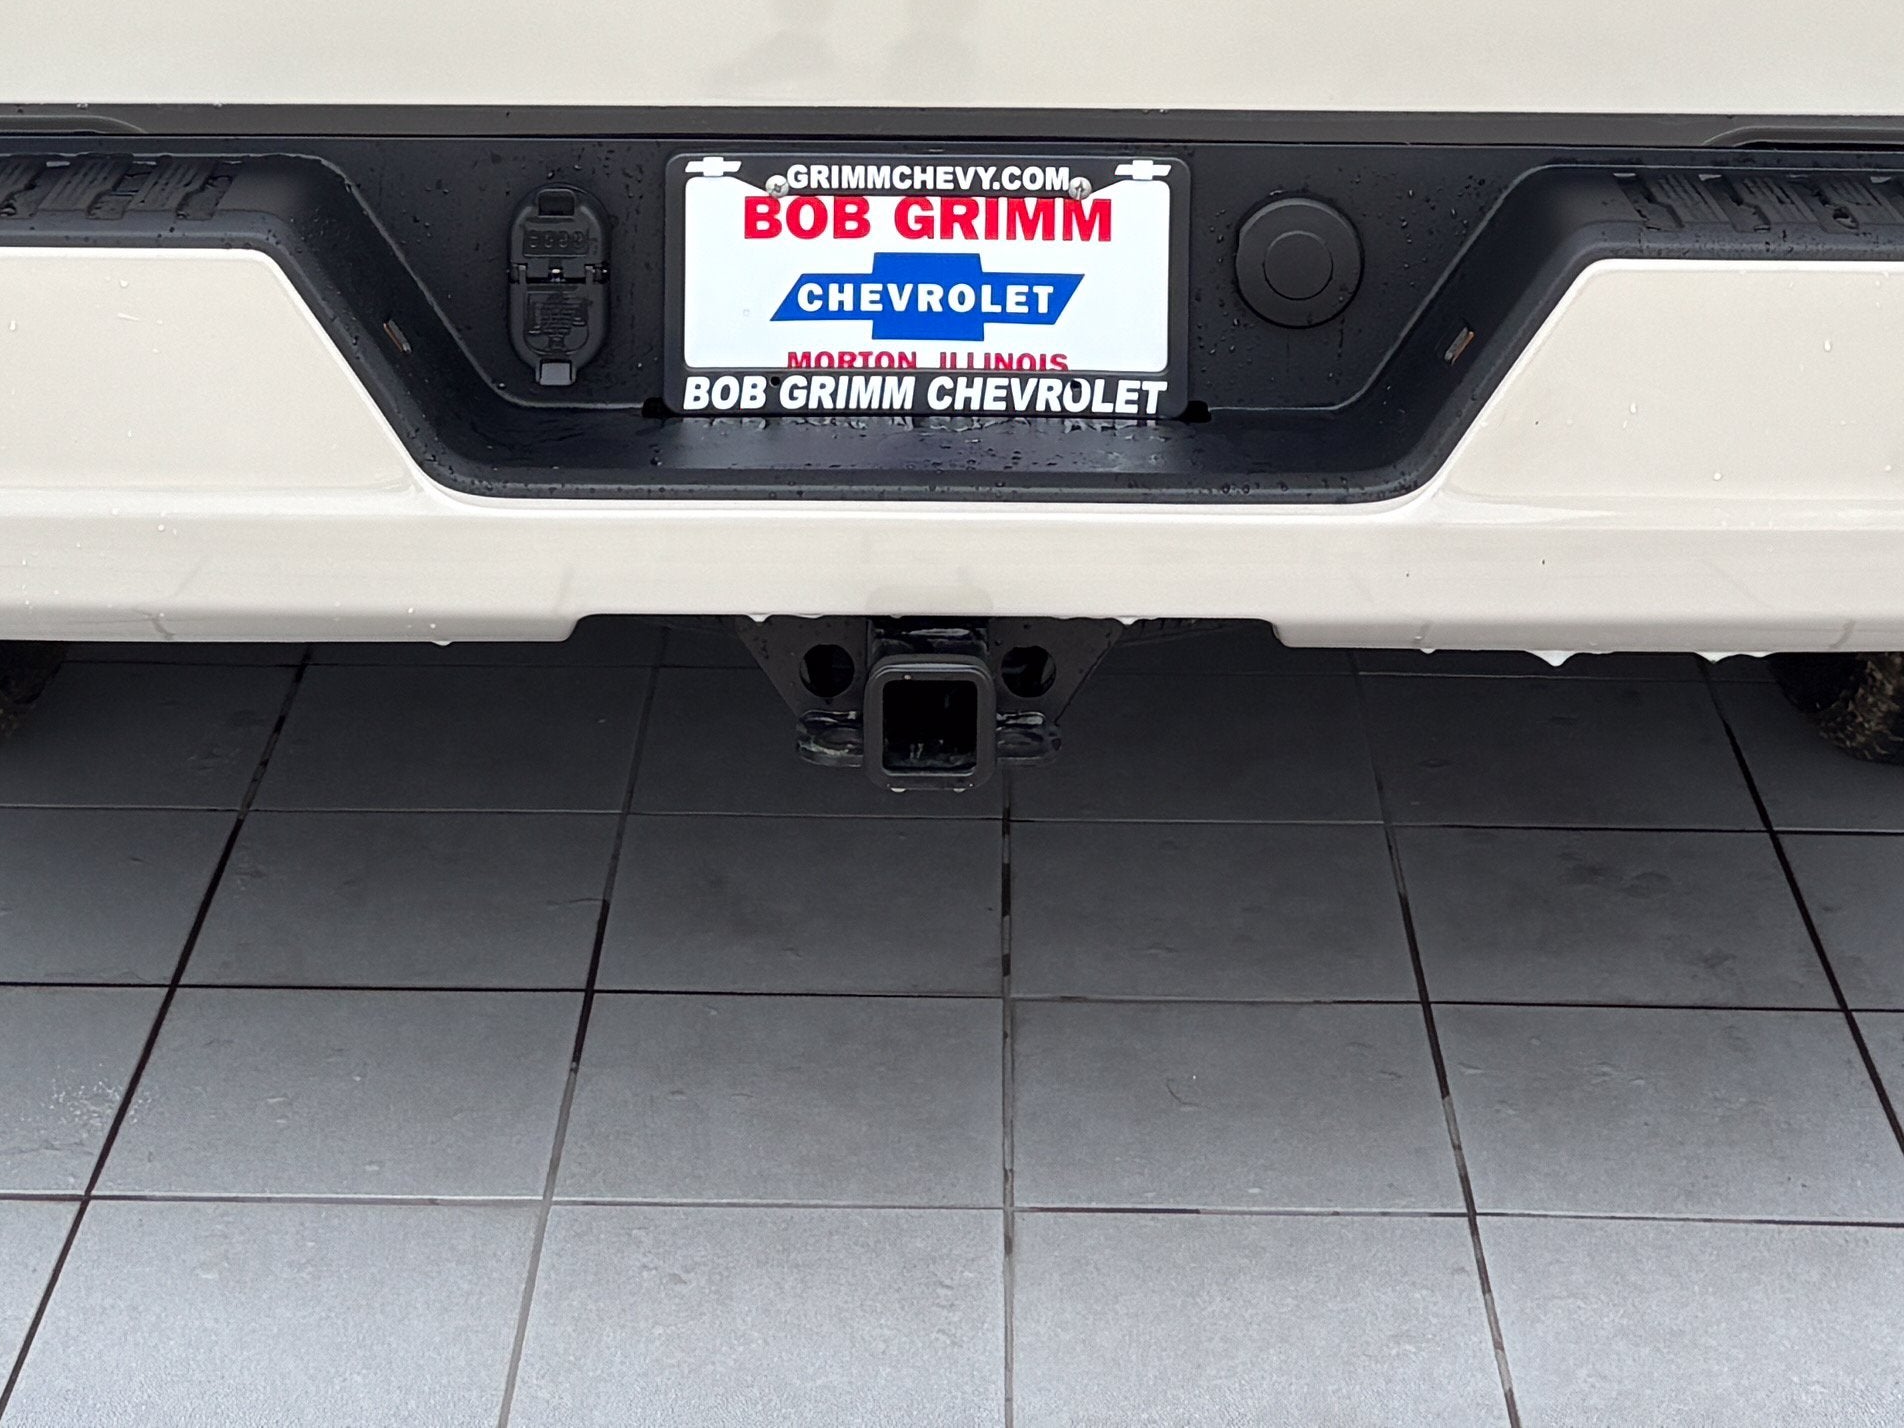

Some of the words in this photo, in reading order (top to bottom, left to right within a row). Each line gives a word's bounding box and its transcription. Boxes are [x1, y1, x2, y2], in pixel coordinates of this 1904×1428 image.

[786, 164, 1071, 192] GRIMMCHEVY.COM
[744, 195, 871, 240] BOB
[893, 196, 1112, 242] GRIMM
[797, 282, 1055, 314] CHEVROLET
[786, 350, 917, 370] MORTON
[683, 375, 767, 411] BOB
[778, 375, 916, 411] GRIMM
[926, 376, 1169, 415] CHEVROLET
